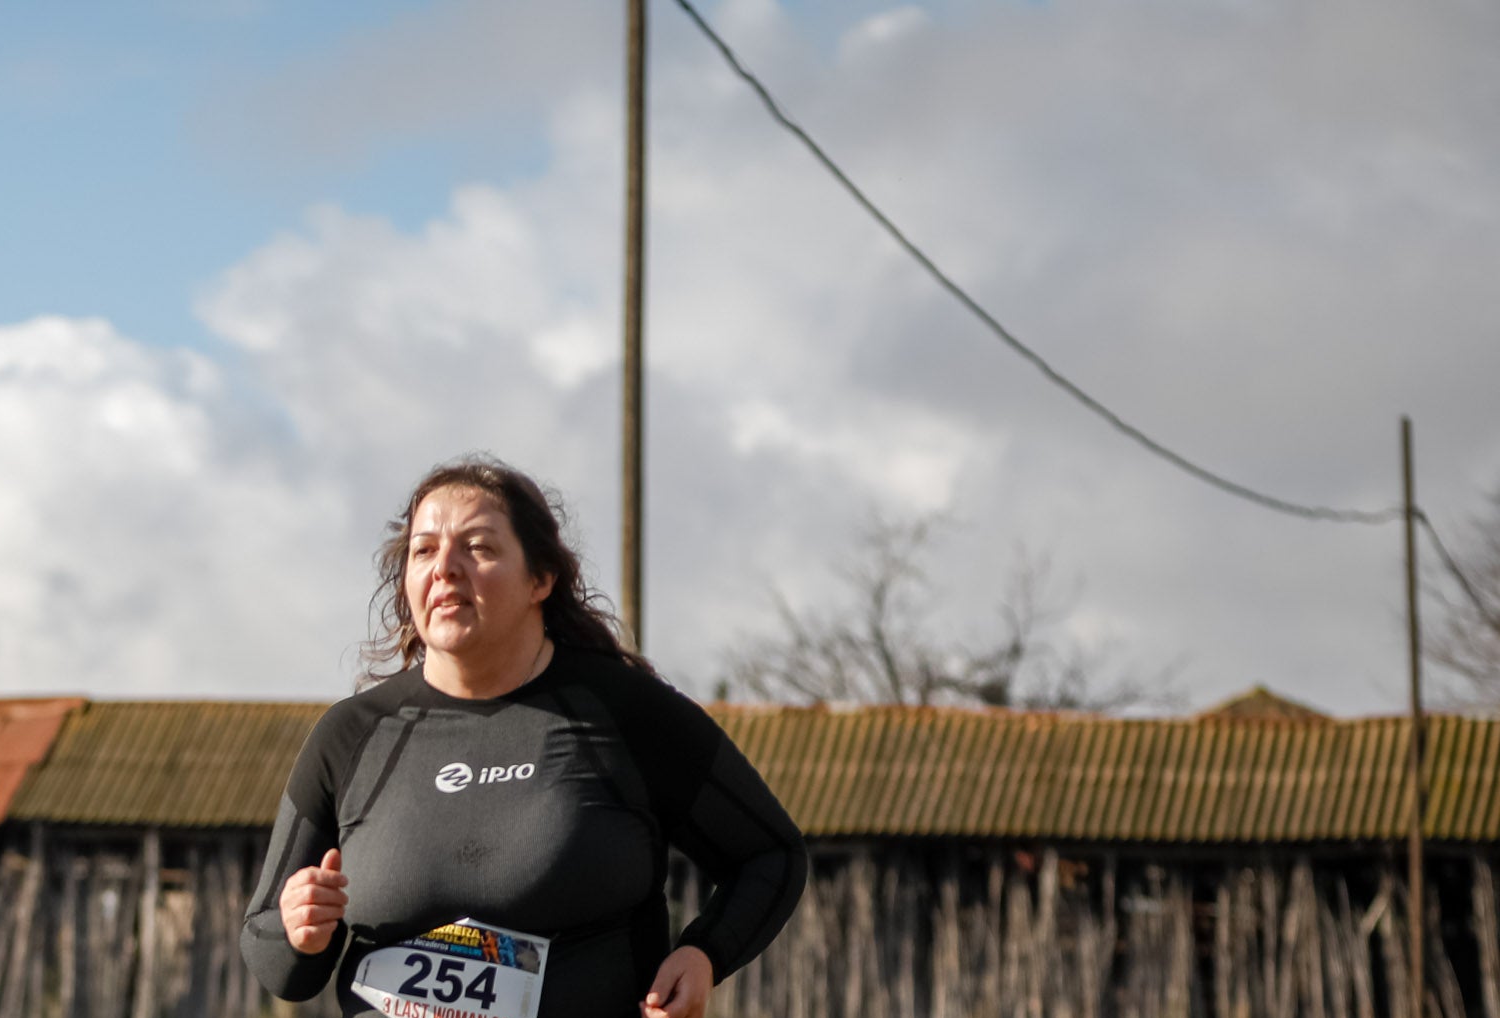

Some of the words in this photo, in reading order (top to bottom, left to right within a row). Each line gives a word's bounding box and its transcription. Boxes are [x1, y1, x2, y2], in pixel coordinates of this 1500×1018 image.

[420, 932, 479, 947] OPULAR
[398, 953, 497, 1010] 254
[383, 997, 392, 1014] 3
